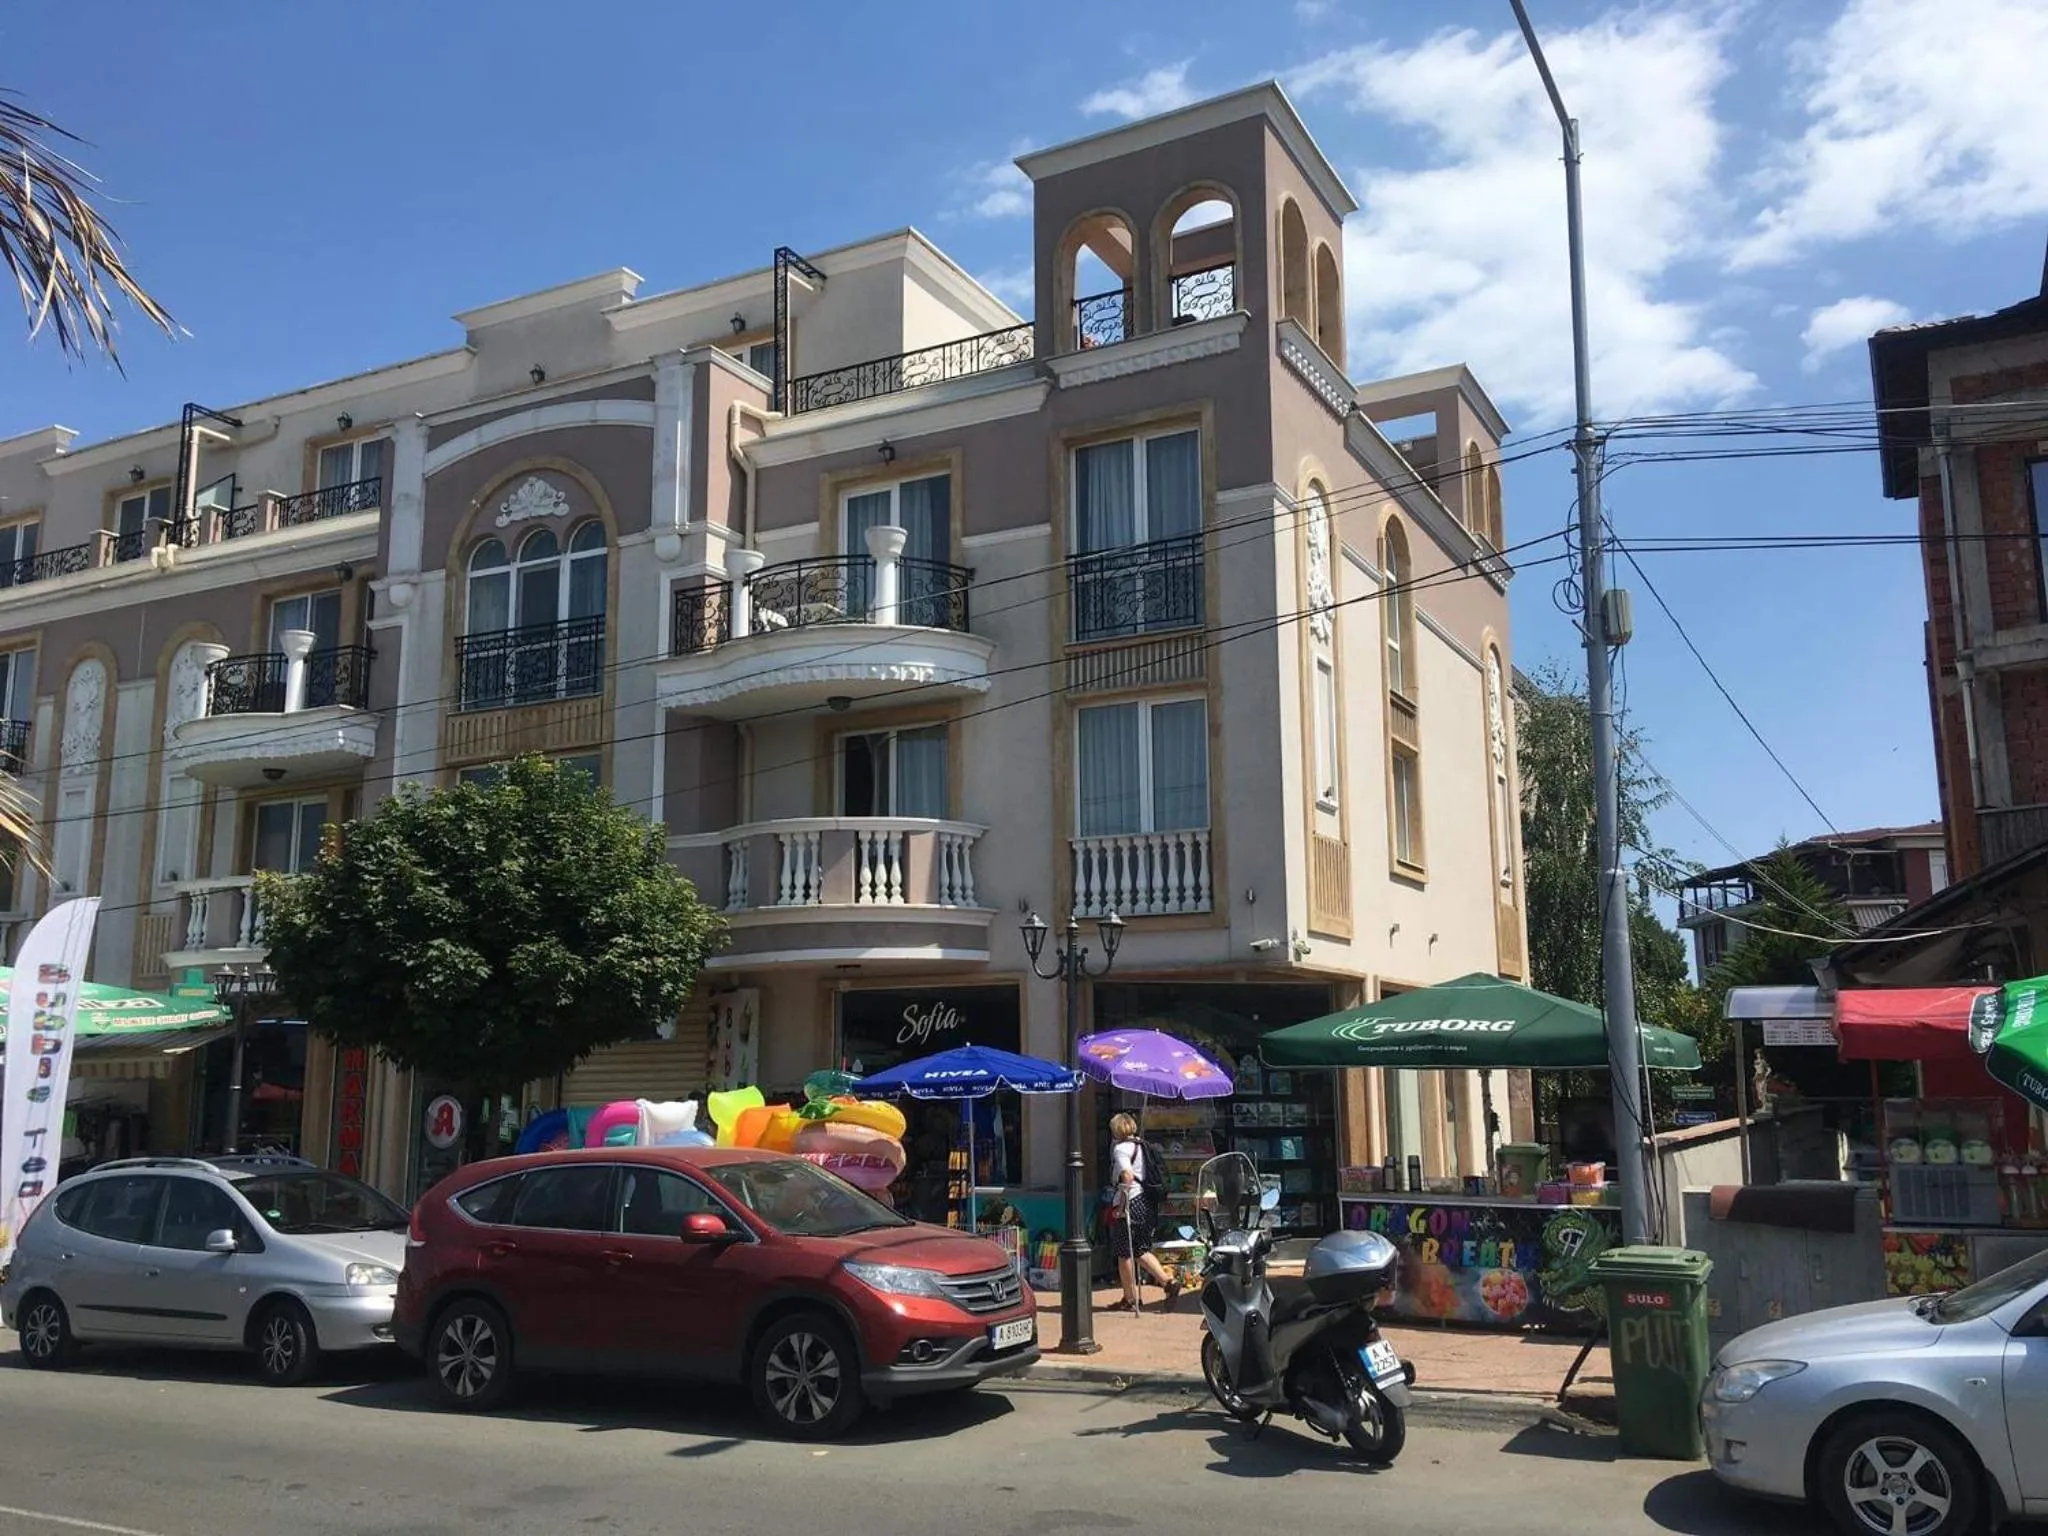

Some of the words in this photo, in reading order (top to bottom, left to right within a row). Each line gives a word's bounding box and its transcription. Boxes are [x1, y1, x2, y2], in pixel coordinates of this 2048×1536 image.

[896, 1001, 961, 1045] Sofia
[1373, 1018, 1516, 1034] TUBORG
[924, 1069, 989, 1079] NIVEA
[1350, 1204, 1471, 1236] DRAGON
[1421, 1236, 1543, 1269] BREATH
[1627, 1293, 1665, 1305] SULO
